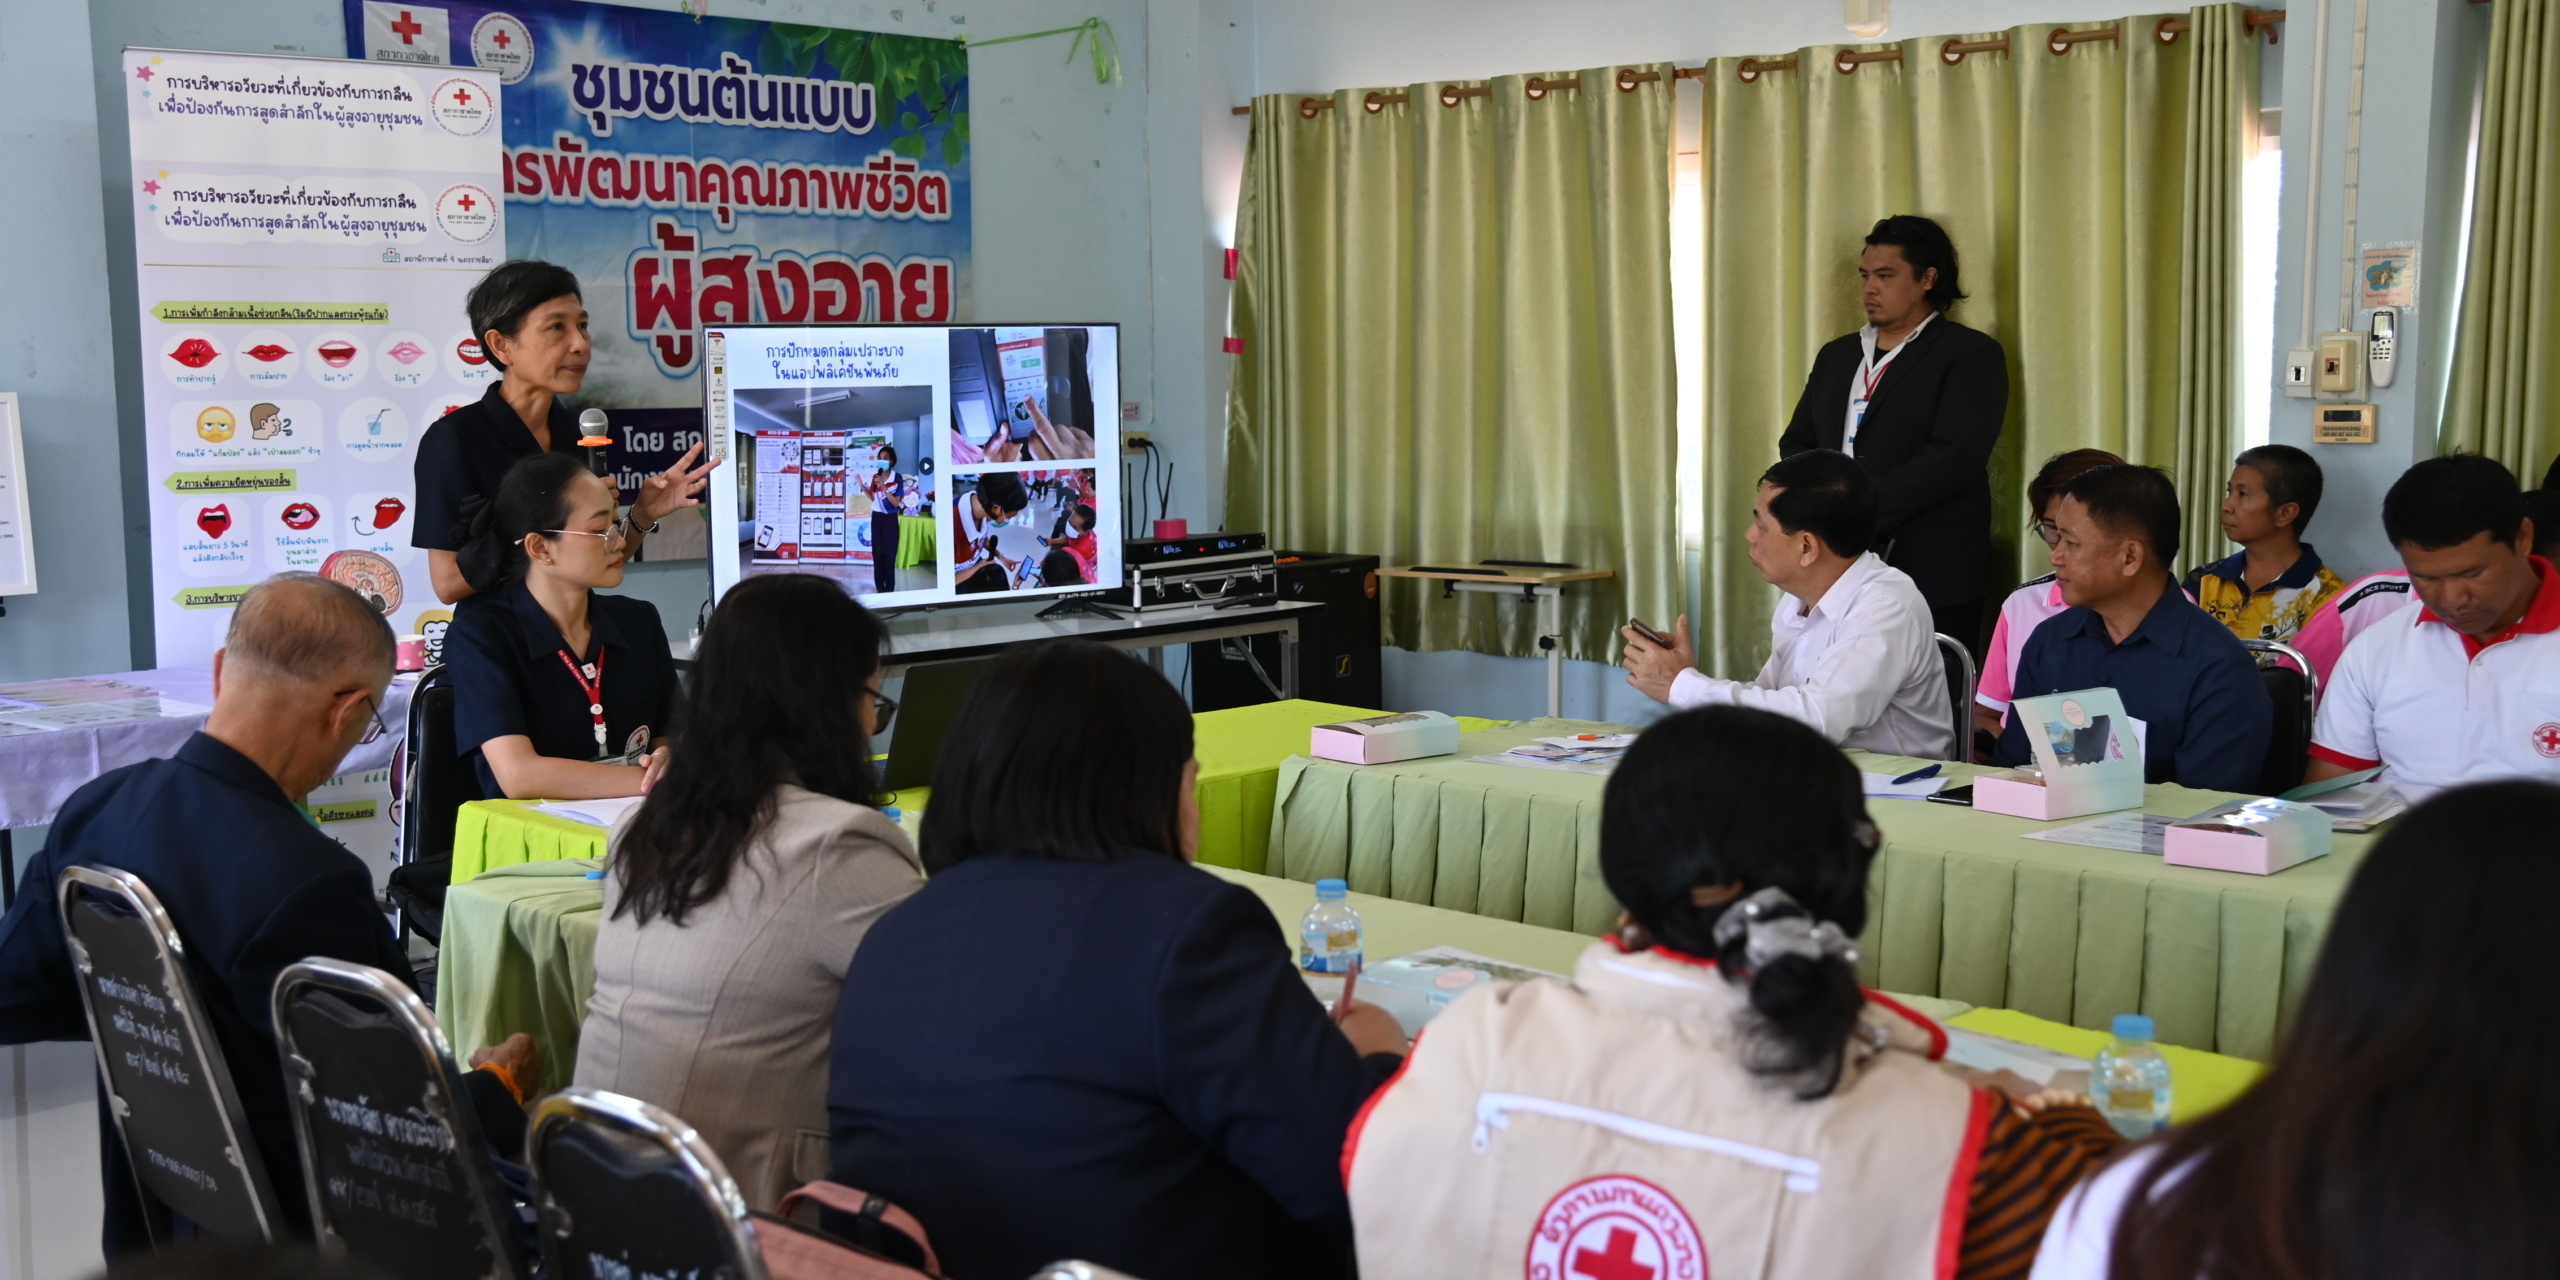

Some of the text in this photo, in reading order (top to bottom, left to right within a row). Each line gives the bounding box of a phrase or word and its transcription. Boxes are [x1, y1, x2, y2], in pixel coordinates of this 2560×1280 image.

[166, 75, 413, 102] การบริหารอวัยวะที่เกี่ยวข้องกับการกลืน
[572, 57, 872, 131] ชุมชนต้นแบบ
[504, 138, 948, 225] ารพัฒนาคุณภาพชีวิต
[173, 185, 417, 209] การบริหารอวัยวะที่เกี่ยวข้องกับการกลืน
[633, 223, 951, 368] ผู้สงอาย
[623, 426, 665, 453] โดย
[715, 448, 726, 457] 55
[185, 591, 246, 605] 3.การบริหารขา
